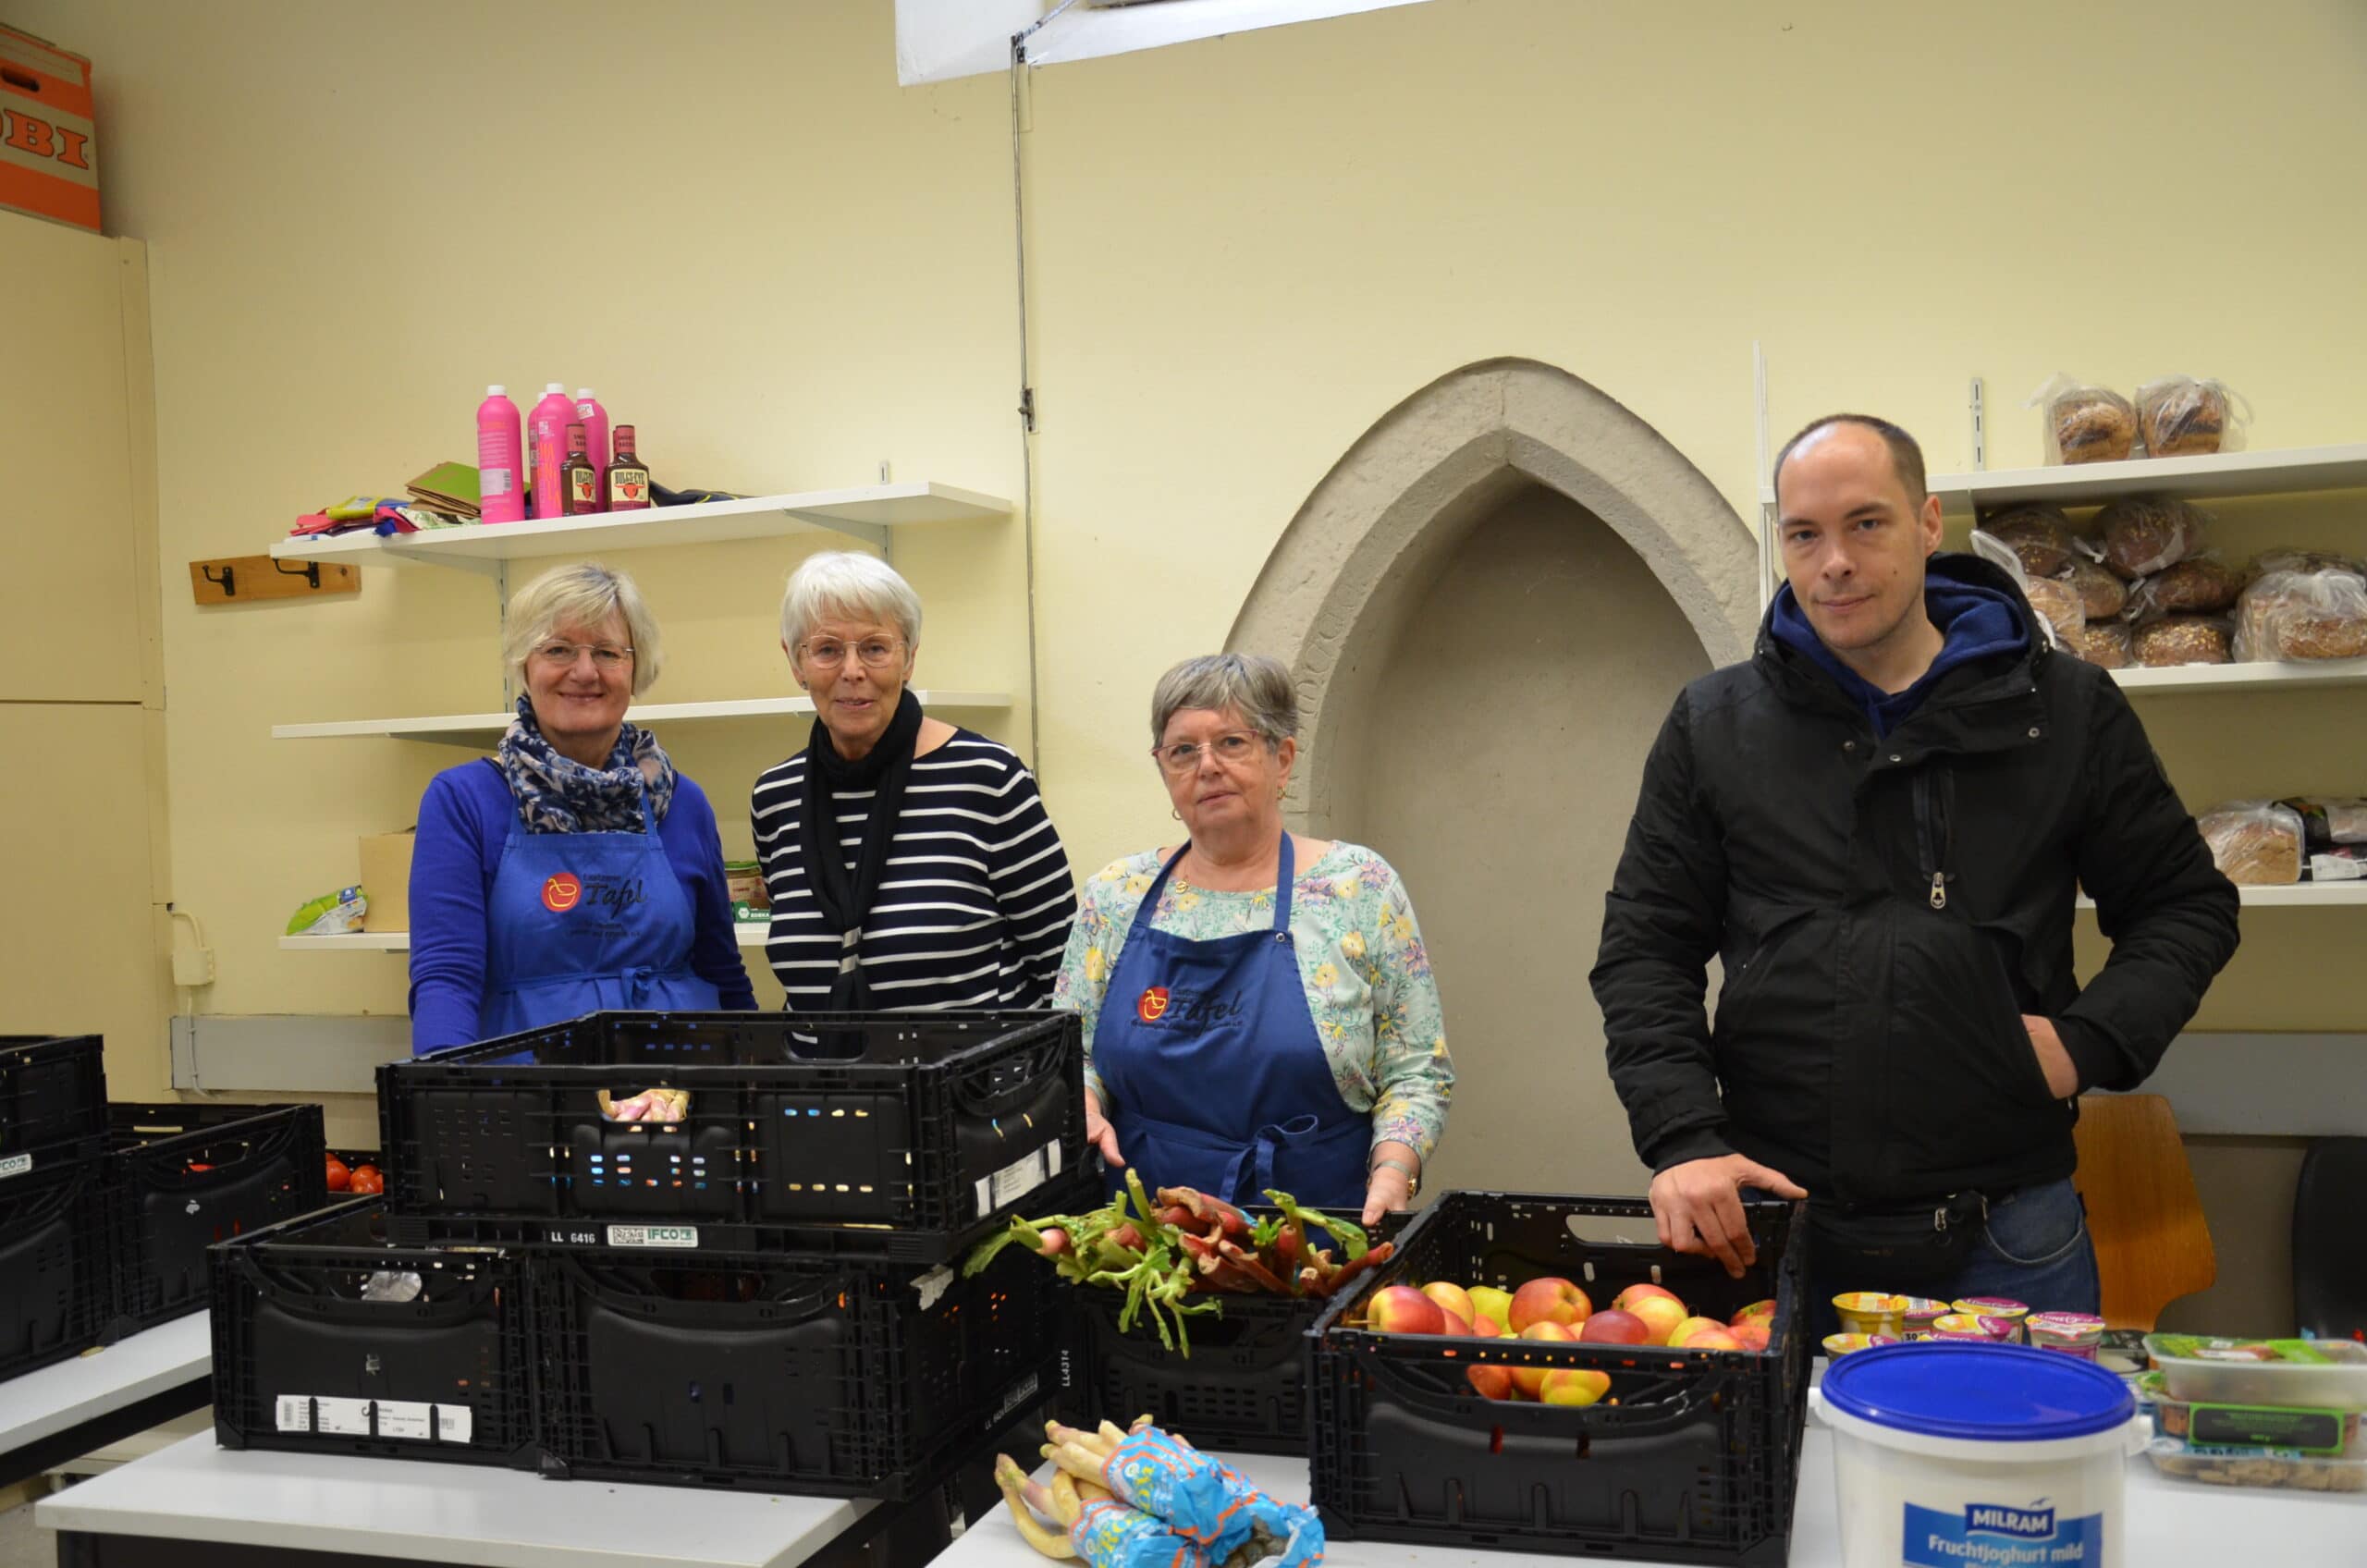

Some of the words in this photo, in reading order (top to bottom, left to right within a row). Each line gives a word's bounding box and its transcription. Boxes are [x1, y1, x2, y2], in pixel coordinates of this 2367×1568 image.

[0, 108, 90, 171] BI
[551, 1231, 564, 1243] LL
[570, 1232, 595, 1243] 6416
[647, 1228, 680, 1241] IFCO
[1971, 1509, 2049, 1533] MILRAM
[1928, 1534, 2048, 1563] Fruchtjoghurt
[2050, 1541, 2084, 1560] mild
